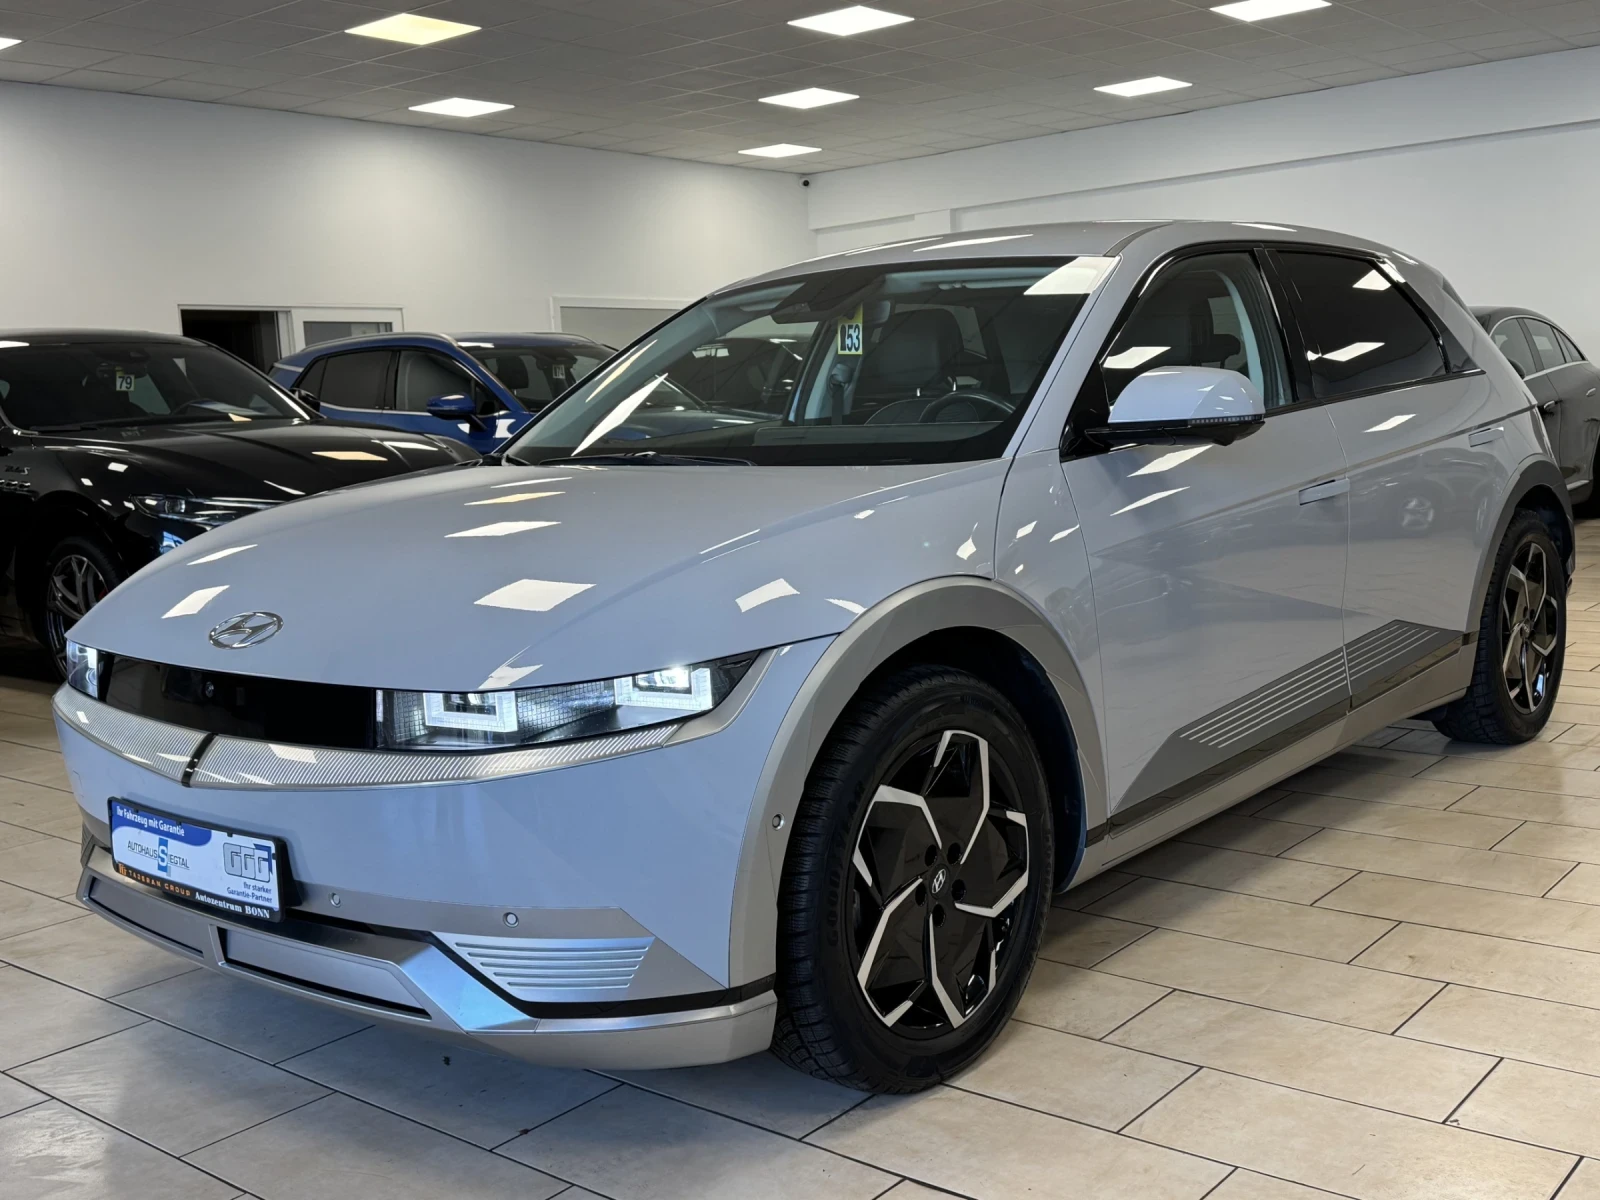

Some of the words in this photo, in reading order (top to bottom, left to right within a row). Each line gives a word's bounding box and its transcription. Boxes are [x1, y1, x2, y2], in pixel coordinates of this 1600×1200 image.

[840, 323, 860, 352] 53
[118, 375, 132, 390] 79
[123, 808, 148, 828] Fahrzeug
[148, 818, 159, 829] mit
[158, 820, 185, 837] Garantie
[127, 840, 158, 859] AUTOHAUS
[226, 886, 273, 904] Garantie-Partner
[243, 881, 251, 890] Ihr
[252, 884, 272, 895] starker
[164, 883, 191, 897] GROUP
[195, 891, 242, 913] Autozentrum
[244, 905, 270, 919] BONN
